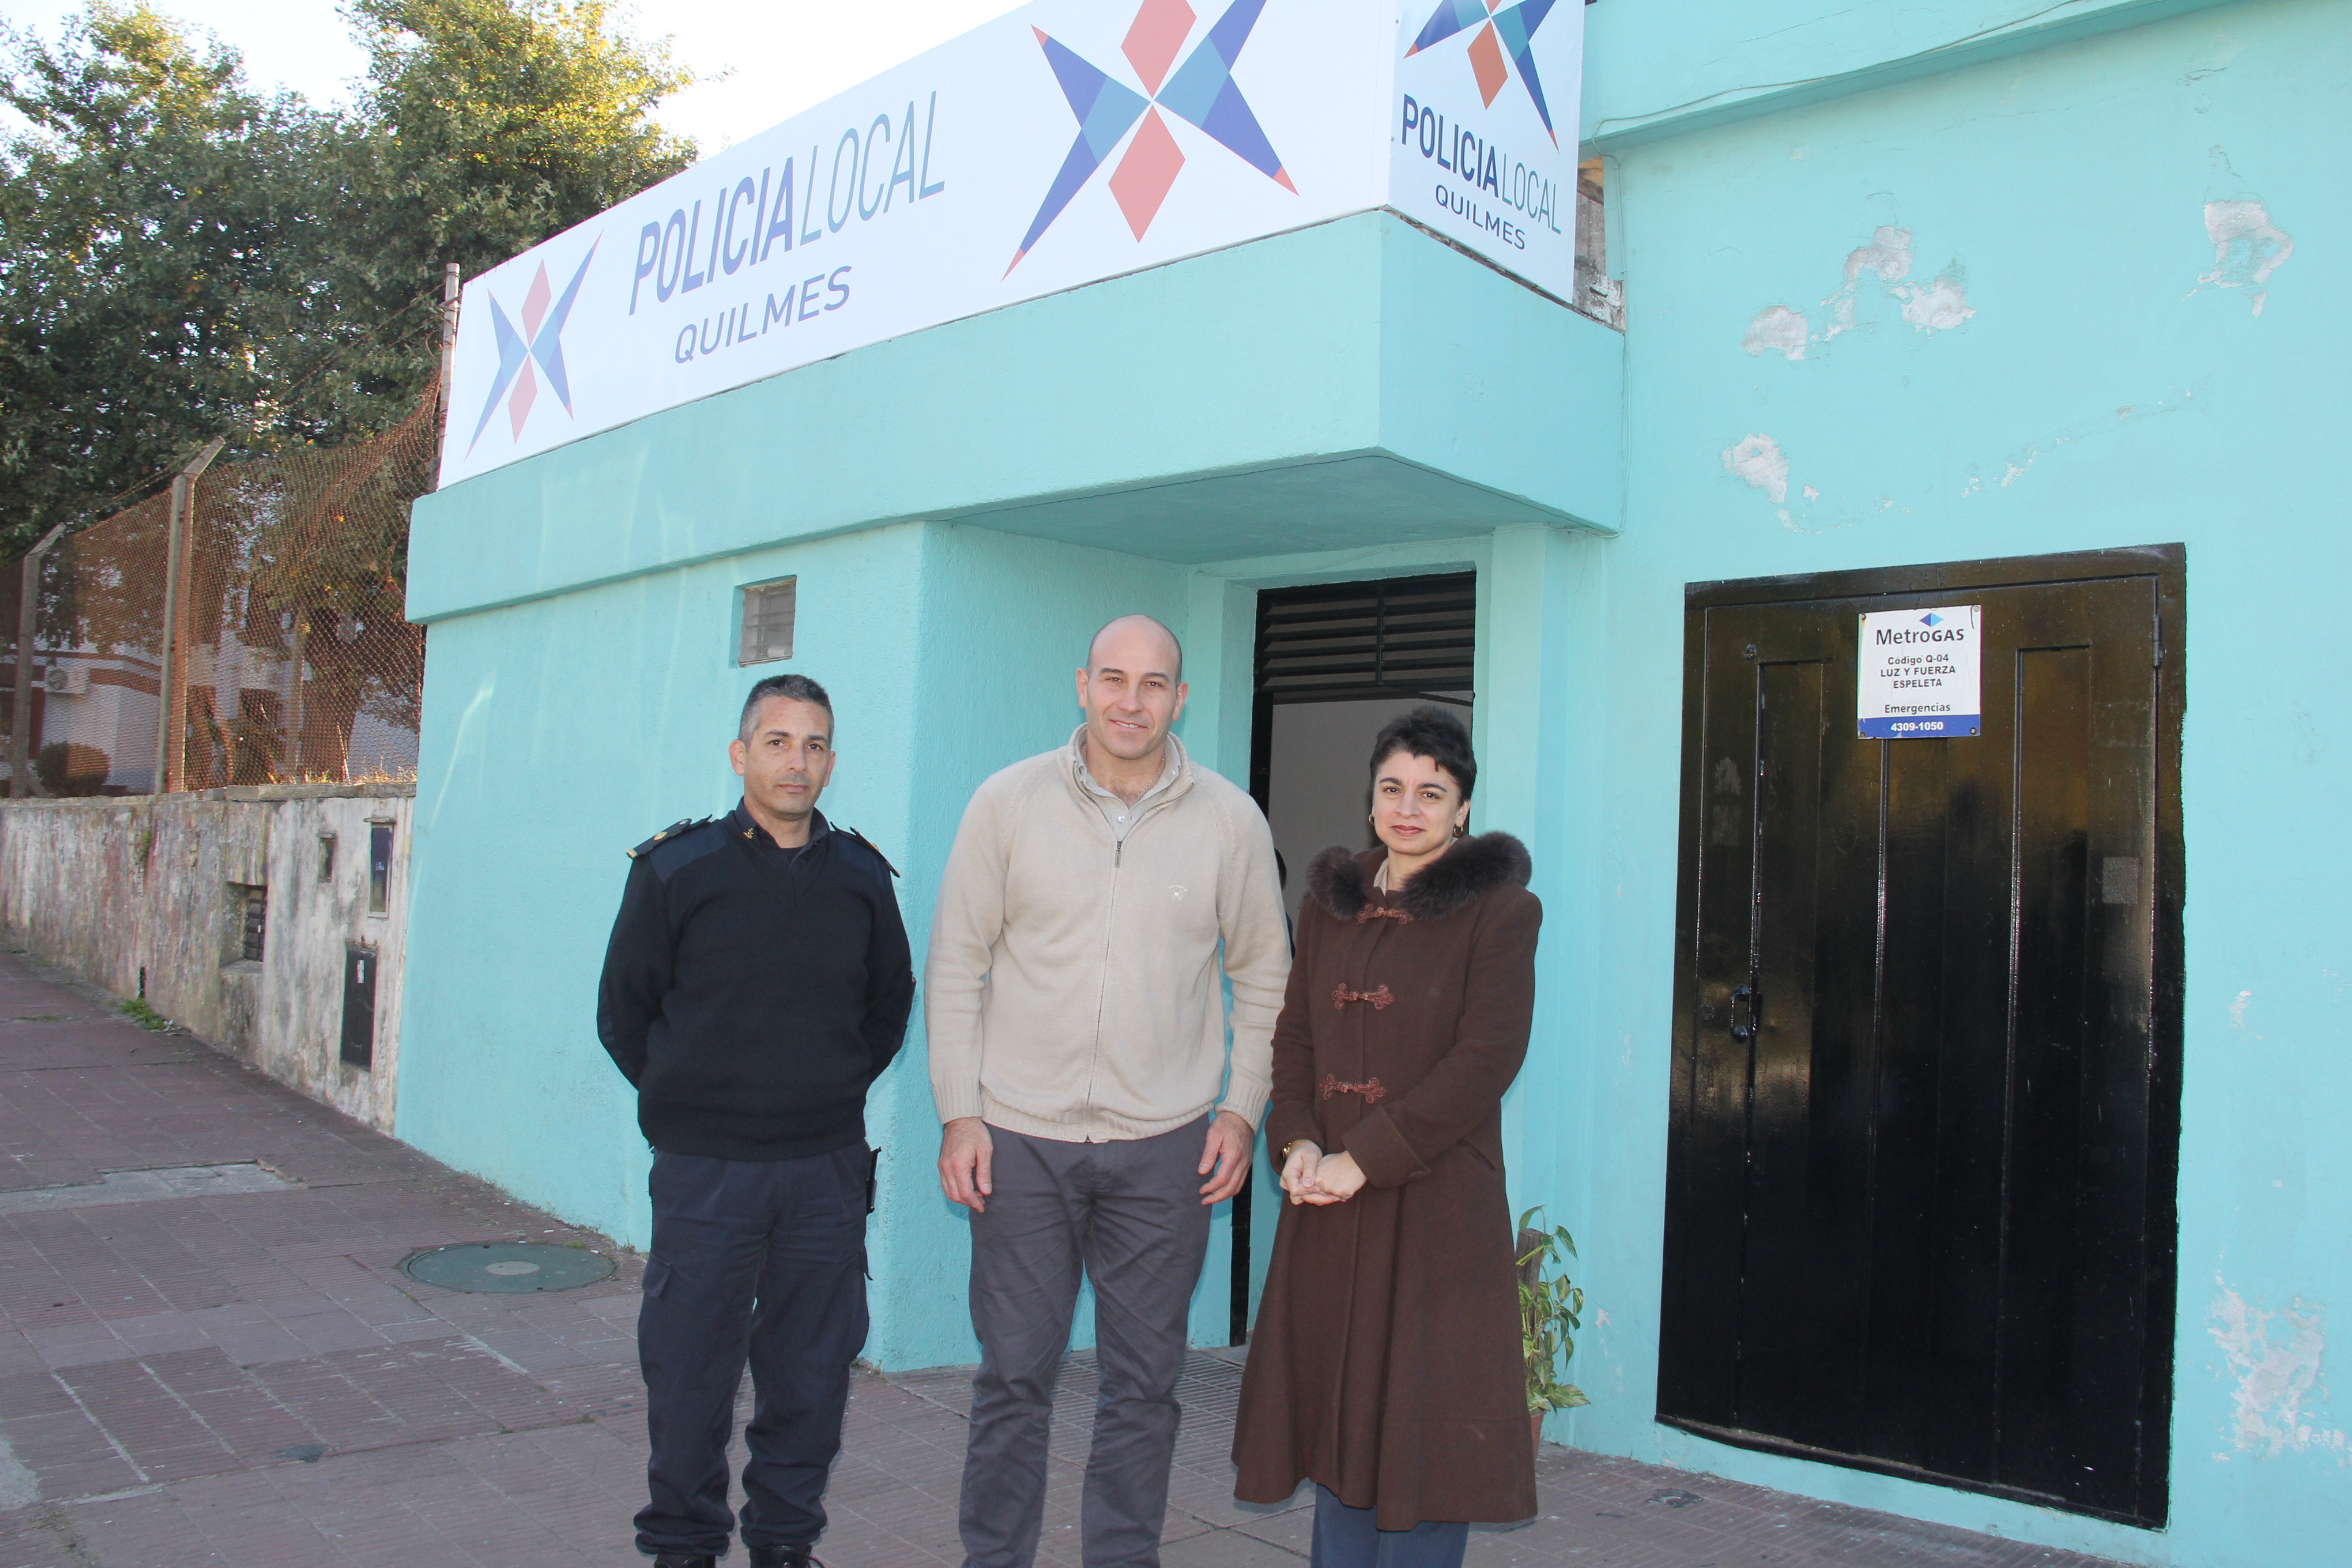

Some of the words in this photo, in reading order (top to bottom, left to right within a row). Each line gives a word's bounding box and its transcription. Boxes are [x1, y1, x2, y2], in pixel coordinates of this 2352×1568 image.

[1435, 184, 1526, 250] QUILMES
[674, 265, 853, 364] QUILMES
[1876, 628, 1964, 646] MetroGAS
[1887, 655, 1923, 666] Código
[1925, 654, 1949, 664] Q-04
[1880, 668, 1900, 678] LUZ
[1904, 668, 1911, 676] Y
[1914, 666, 1956, 676] FUERZA
[1893, 678, 1942, 689] ESPELETA
[1884, 702, 1951, 715] Emergencias
[1890, 721, 1944, 732] 4309-1050
